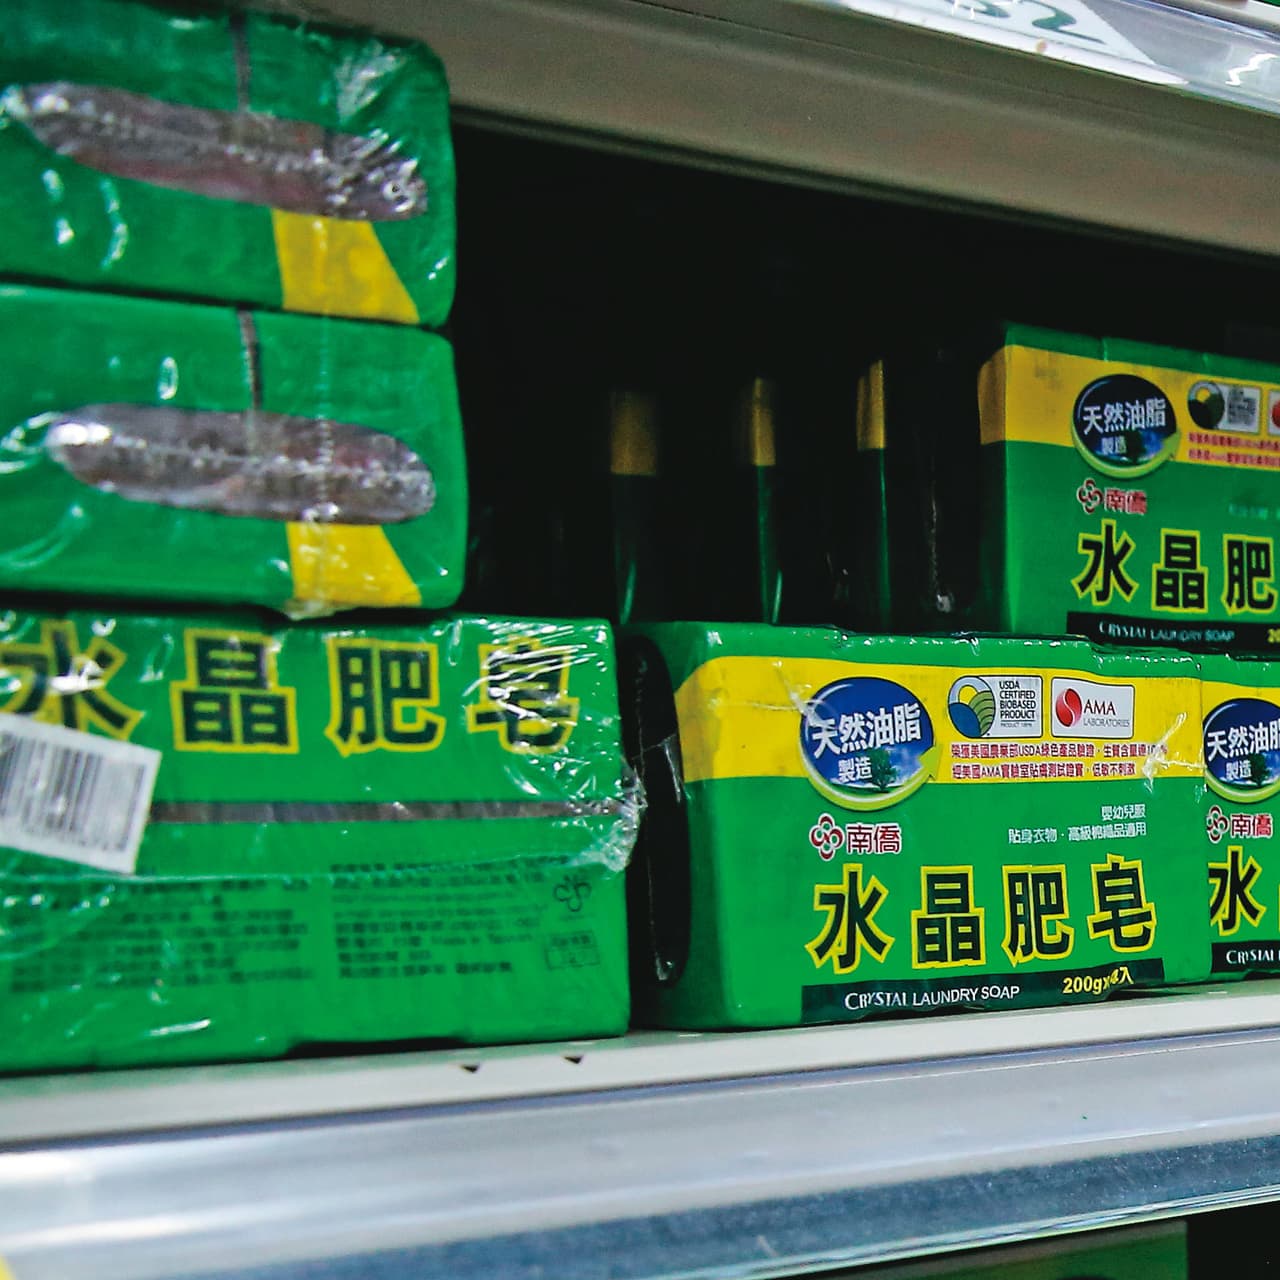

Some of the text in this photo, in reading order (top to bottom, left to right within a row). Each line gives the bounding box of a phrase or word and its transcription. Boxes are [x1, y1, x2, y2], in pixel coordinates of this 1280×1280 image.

[1082, 398, 1166, 435] 天然油脂
[1150, 628, 1202, 642] LAUNDRY
[1204, 630, 1236, 643] SOAP
[0, 620, 580, 756] 水晶肥皂
[999, 681, 1020, 690] USDA
[1000, 690, 1036, 699] CERTIFIED
[1000, 700, 1036, 710] BIOBASED
[1000, 710, 1036, 720] PRODUCT
[1083, 699, 1116, 716] AMA
[811, 703, 922, 760] 天然油脂
[1083, 718, 1130, 729] LABORATORIES
[837, 757, 872, 782] 製造
[1225, 760, 1252, 780] 製造
[1101, 803, 1147, 821] 嬰幼兒服
[1230, 813, 1273, 839] 南僑
[846, 823, 902, 855] 南僑
[804, 854, 1157, 975] 水晶肥皂
[845, 985, 1020, 1010] CRYSTAL LAUNDRY SOAP
